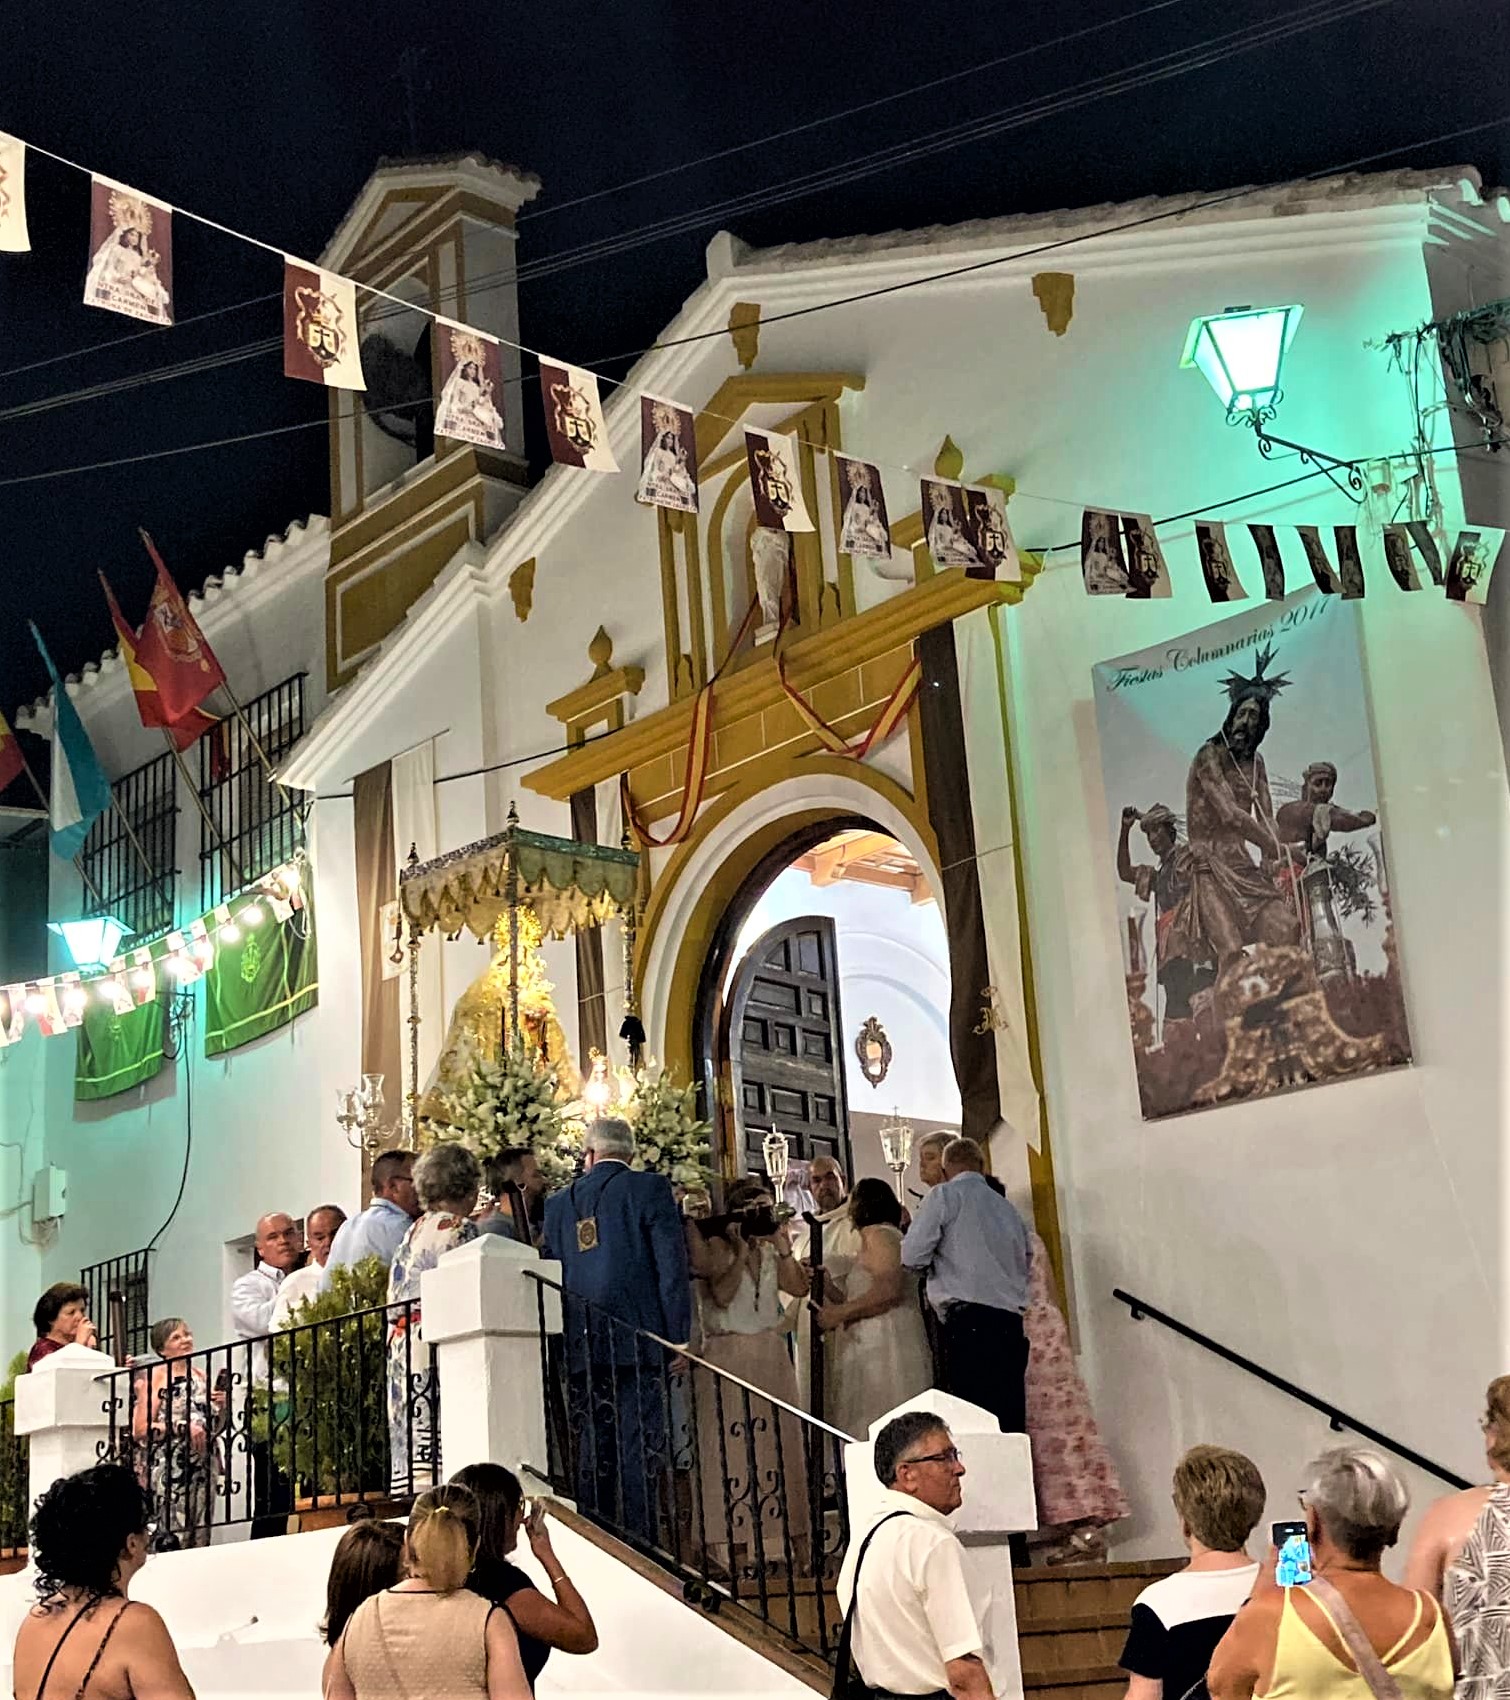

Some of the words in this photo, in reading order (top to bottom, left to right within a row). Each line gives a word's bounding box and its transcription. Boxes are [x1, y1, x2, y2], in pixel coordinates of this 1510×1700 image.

[1106, 665, 1164, 692] Fiestas
[1166, 624, 1274, 672] Columnarias
[1280, 596, 1330, 632] 2017
